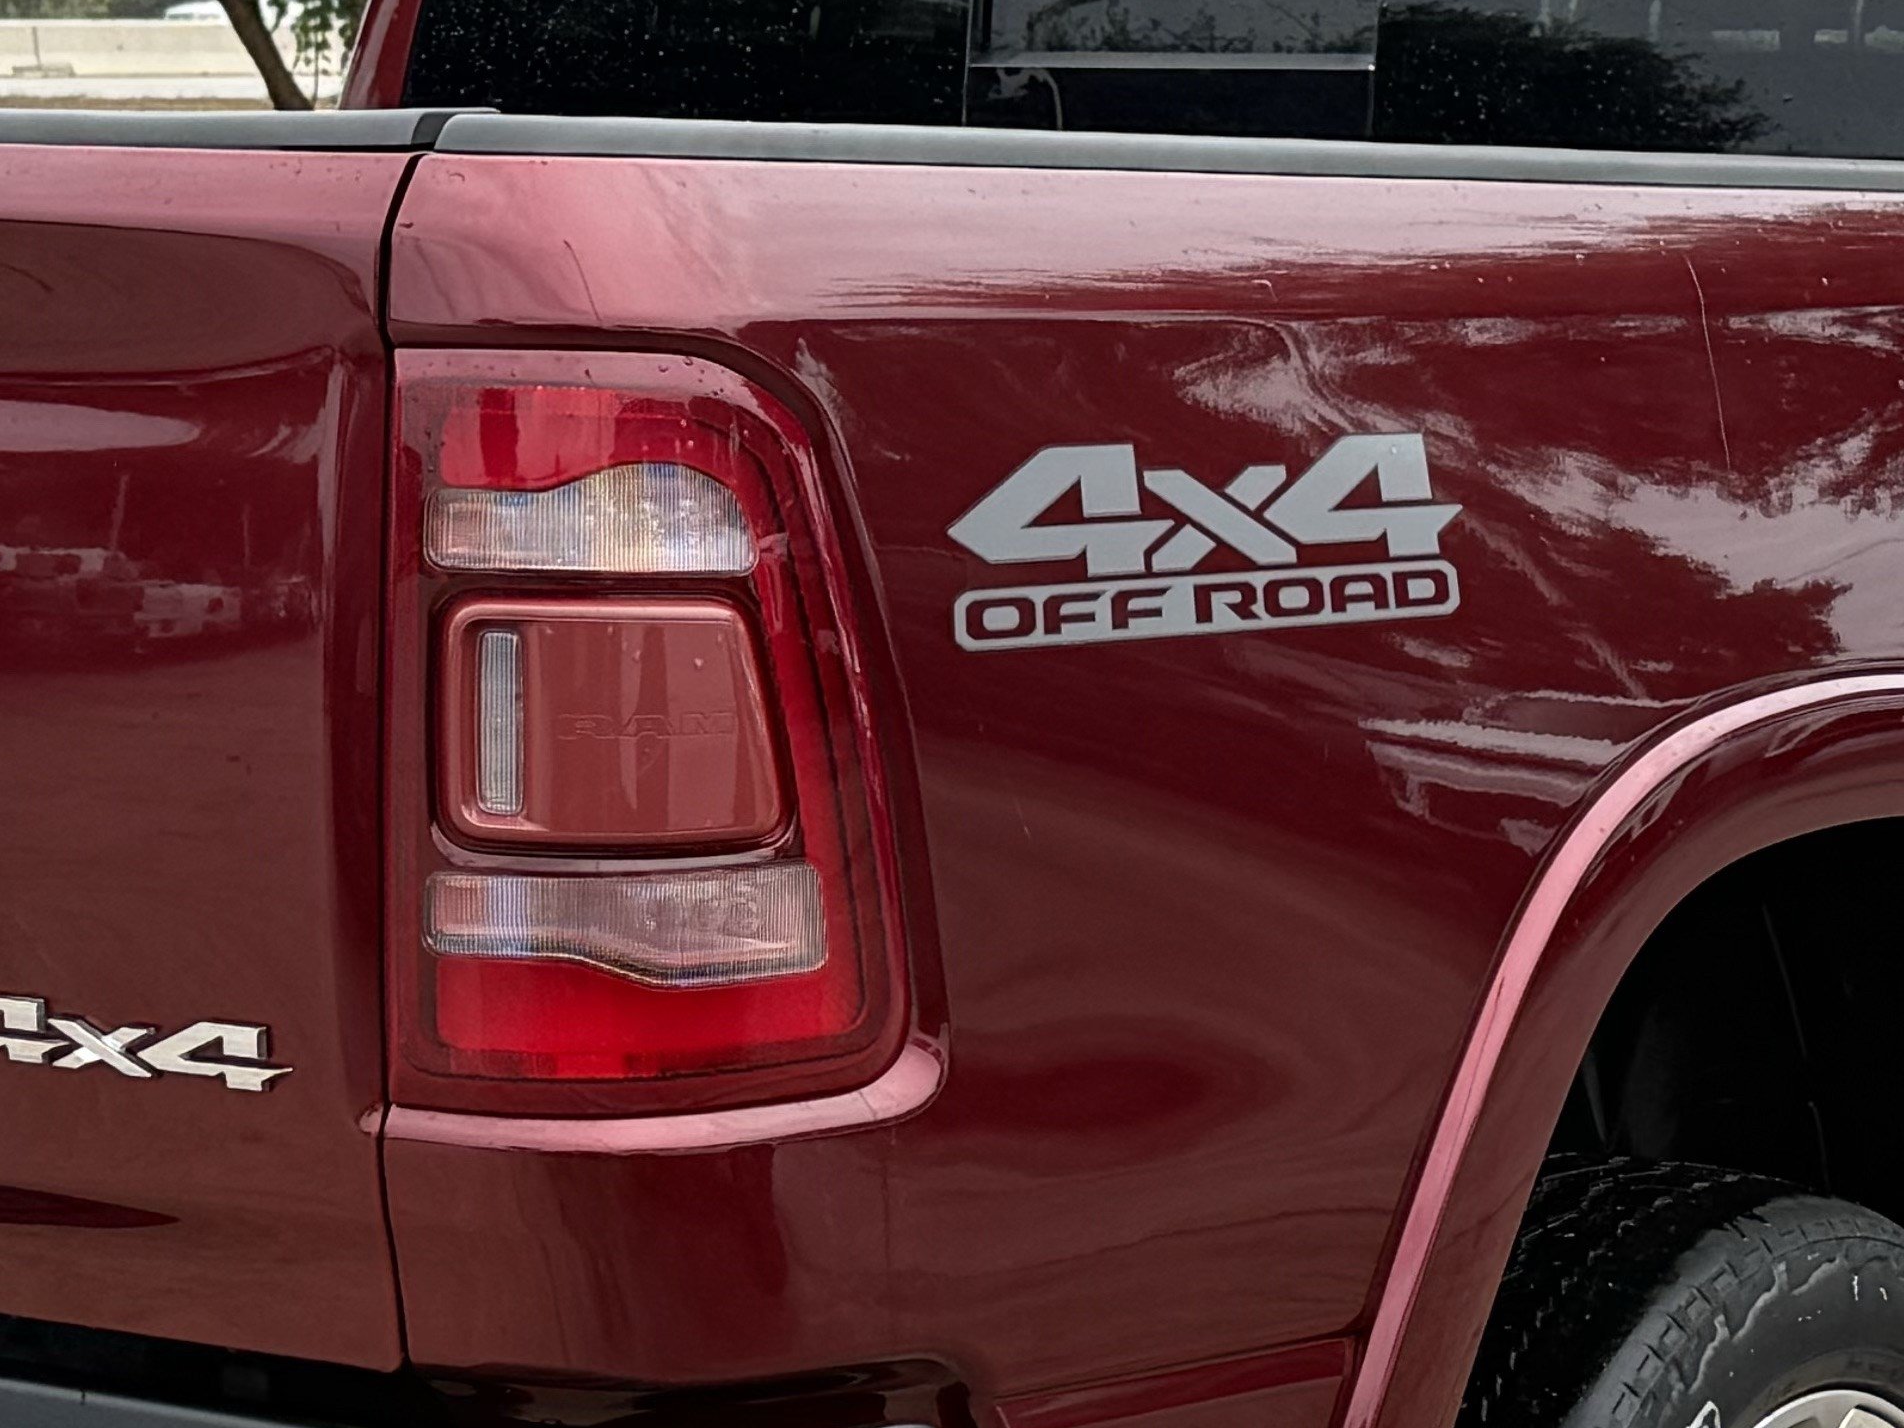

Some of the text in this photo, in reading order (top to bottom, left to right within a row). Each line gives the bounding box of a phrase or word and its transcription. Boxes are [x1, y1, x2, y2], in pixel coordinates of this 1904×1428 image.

[966, 569, 1451, 641] OFF ROAD
[557, 712, 737, 740] RAM
